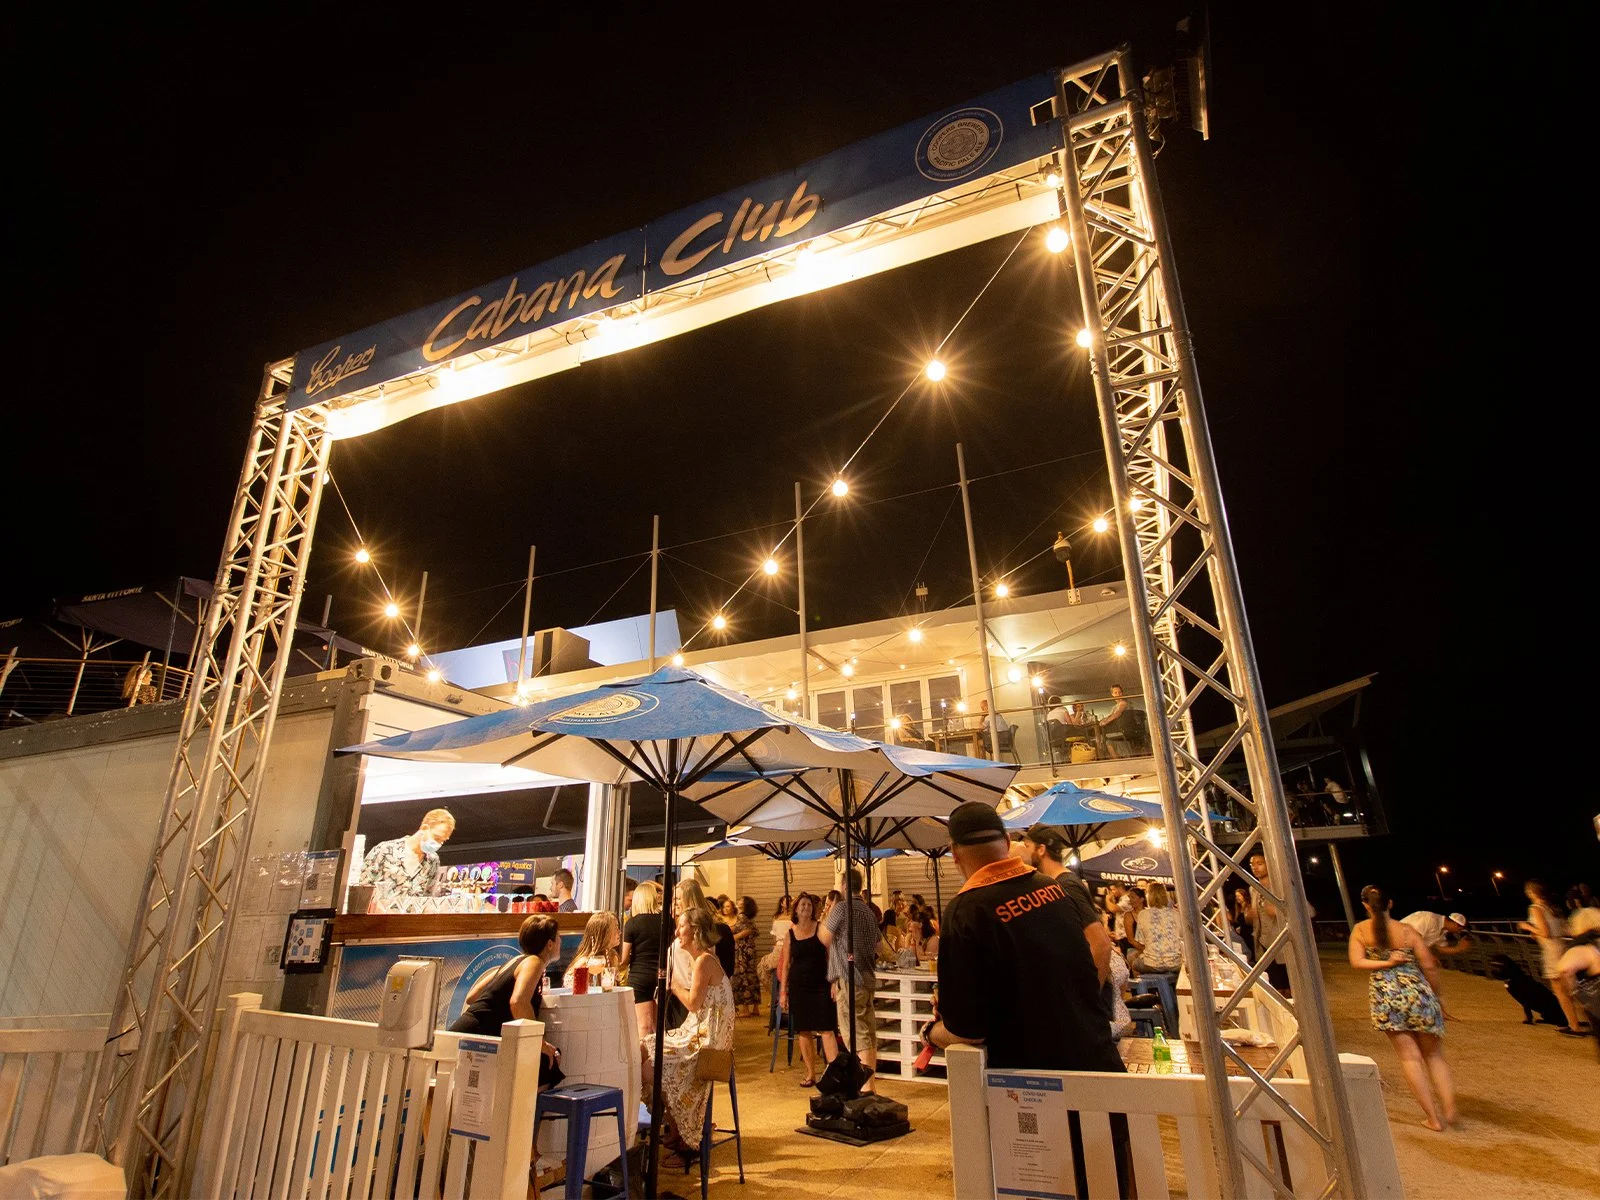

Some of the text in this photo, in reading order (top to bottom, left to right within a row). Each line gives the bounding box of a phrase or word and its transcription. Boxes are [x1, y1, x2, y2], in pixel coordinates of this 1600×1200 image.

[933, 155, 957, 168] PACIFIC
[957, 154, 974, 166] PALE
[974, 140, 985, 154] ALE
[421, 180, 822, 362] Cabana Club
[305, 344, 377, 396] Coopers
[1100, 872, 1130, 882] SANTA
[995, 883, 1066, 923] SECURITY
